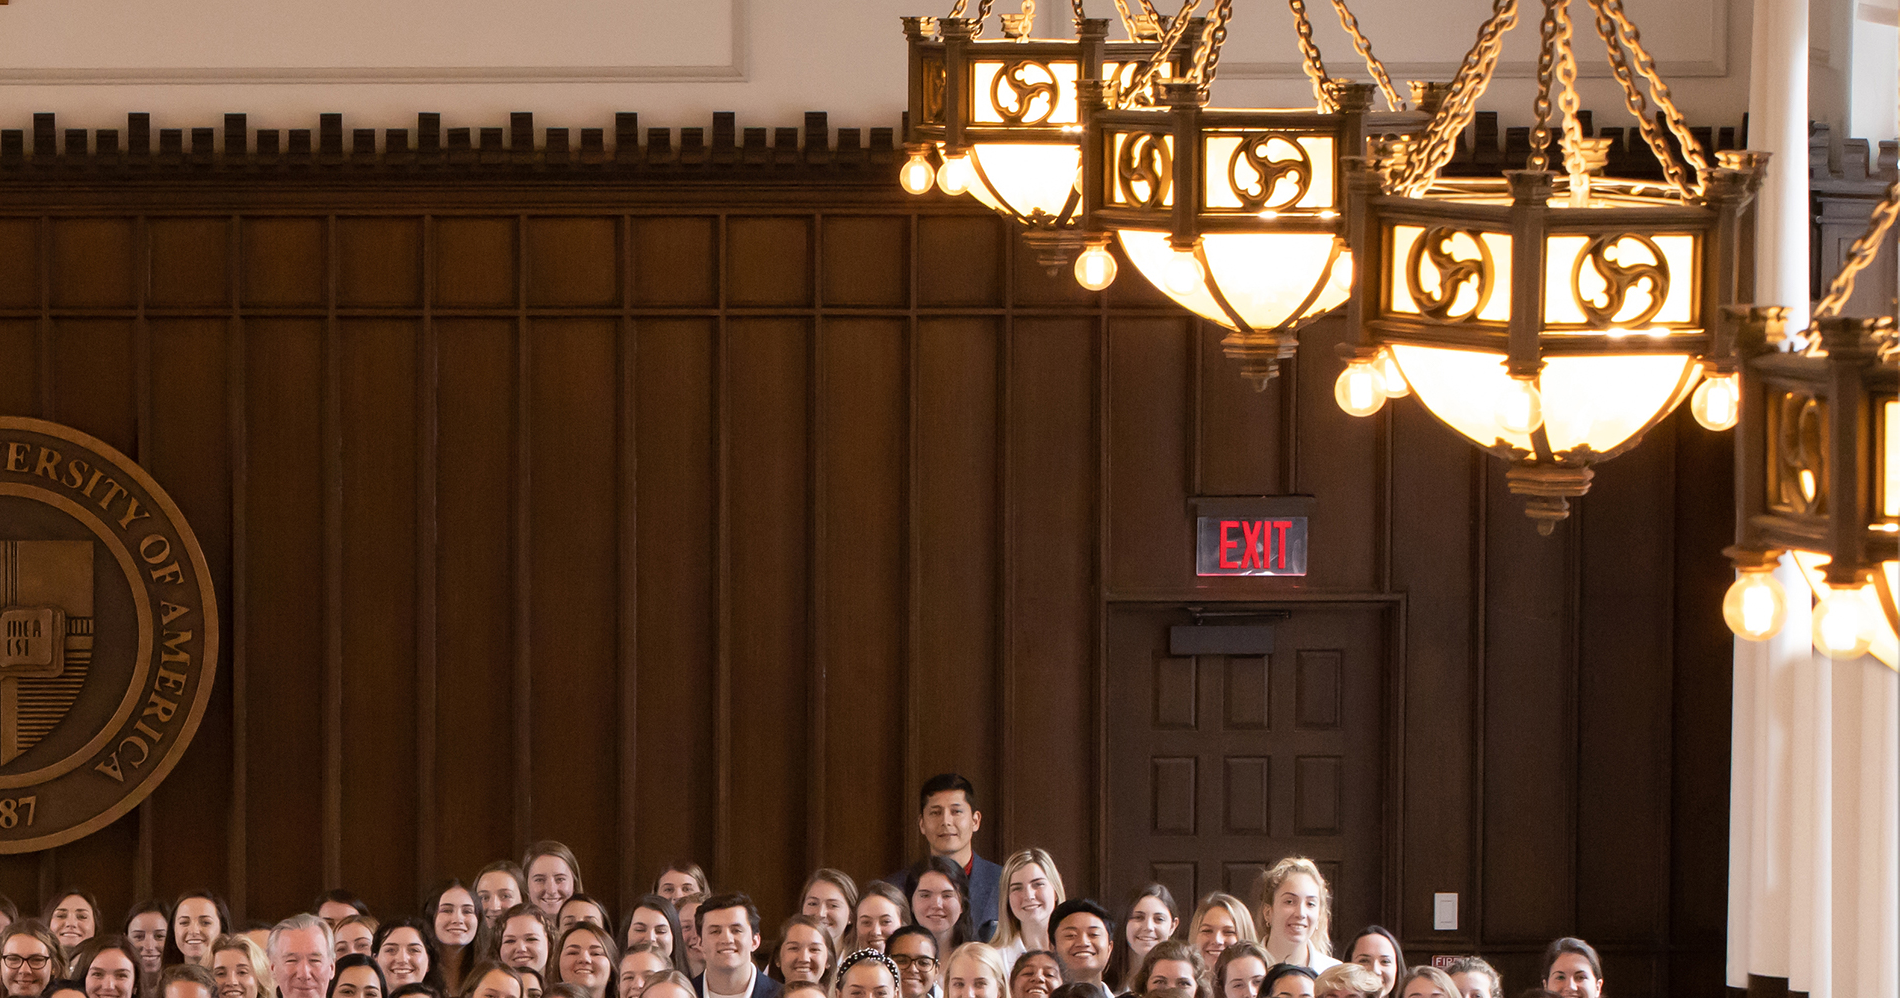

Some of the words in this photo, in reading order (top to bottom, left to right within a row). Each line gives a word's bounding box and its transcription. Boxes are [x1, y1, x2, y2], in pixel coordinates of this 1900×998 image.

[138, 532, 186, 587] OF
[1219, 520, 1293, 570] EXIT
[95, 600, 194, 784] AMERICA
